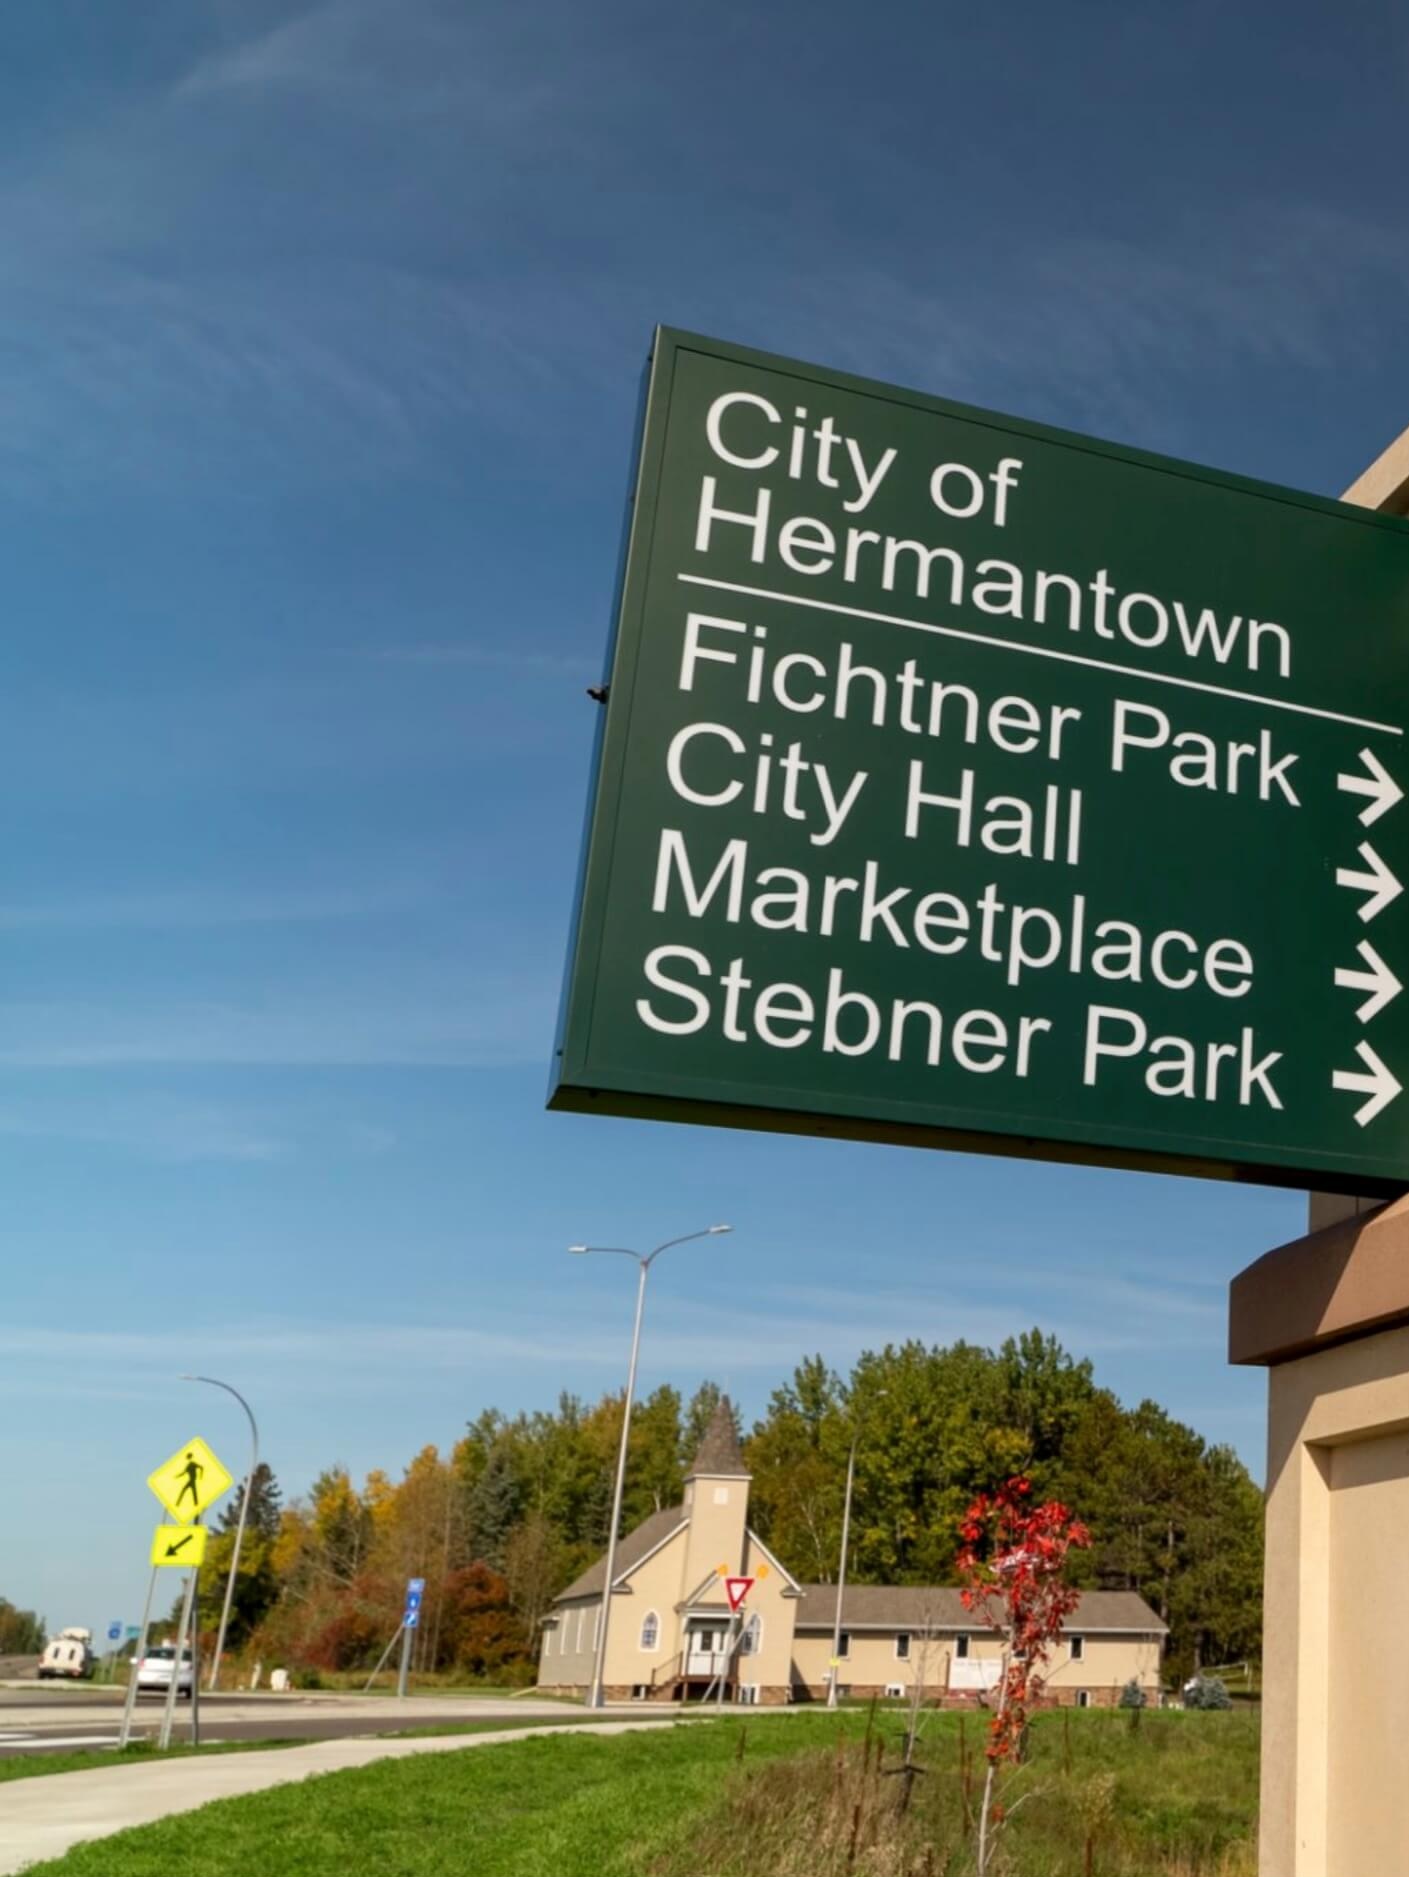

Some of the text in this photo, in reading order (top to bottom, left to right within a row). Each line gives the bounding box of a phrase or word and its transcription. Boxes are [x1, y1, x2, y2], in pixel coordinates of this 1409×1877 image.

[705, 391, 1023, 527] City of
[694, 475, 1291, 678] Hermantown
[666, 722, 1082, 866] City Hall
[678, 612, 1301, 808] Fichtner Park
[652, 828, 1254, 999] Marketplace
[636, 944, 1283, 1111] Stebner Park
